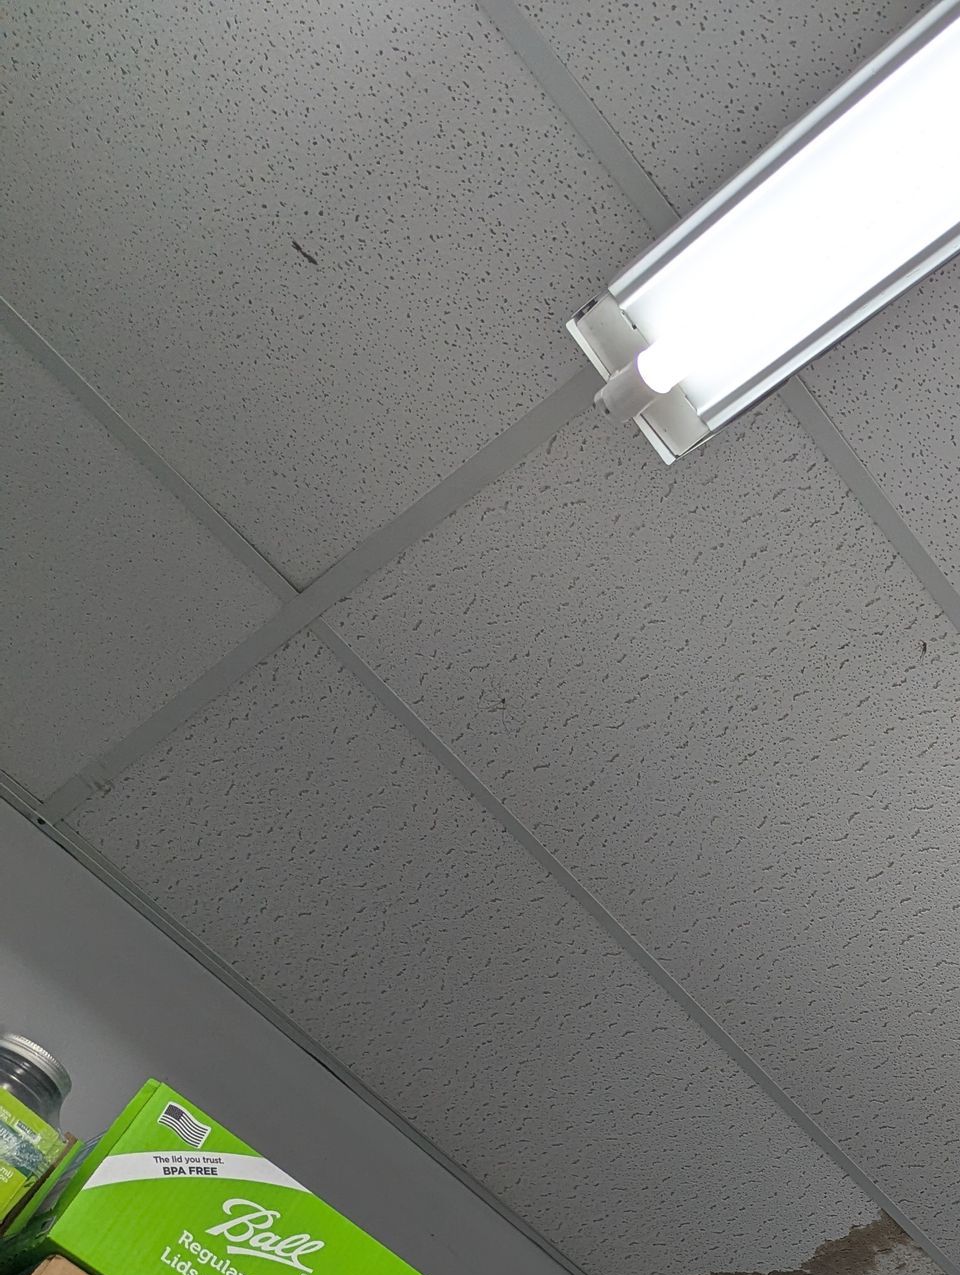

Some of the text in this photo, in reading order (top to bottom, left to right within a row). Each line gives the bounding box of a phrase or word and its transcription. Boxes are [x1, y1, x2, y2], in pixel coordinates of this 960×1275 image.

[153, 1155, 225, 1167] The lid you trust.
[162, 1166, 218, 1176] BPA FREE
[205, 1198, 325, 1273] Ball
